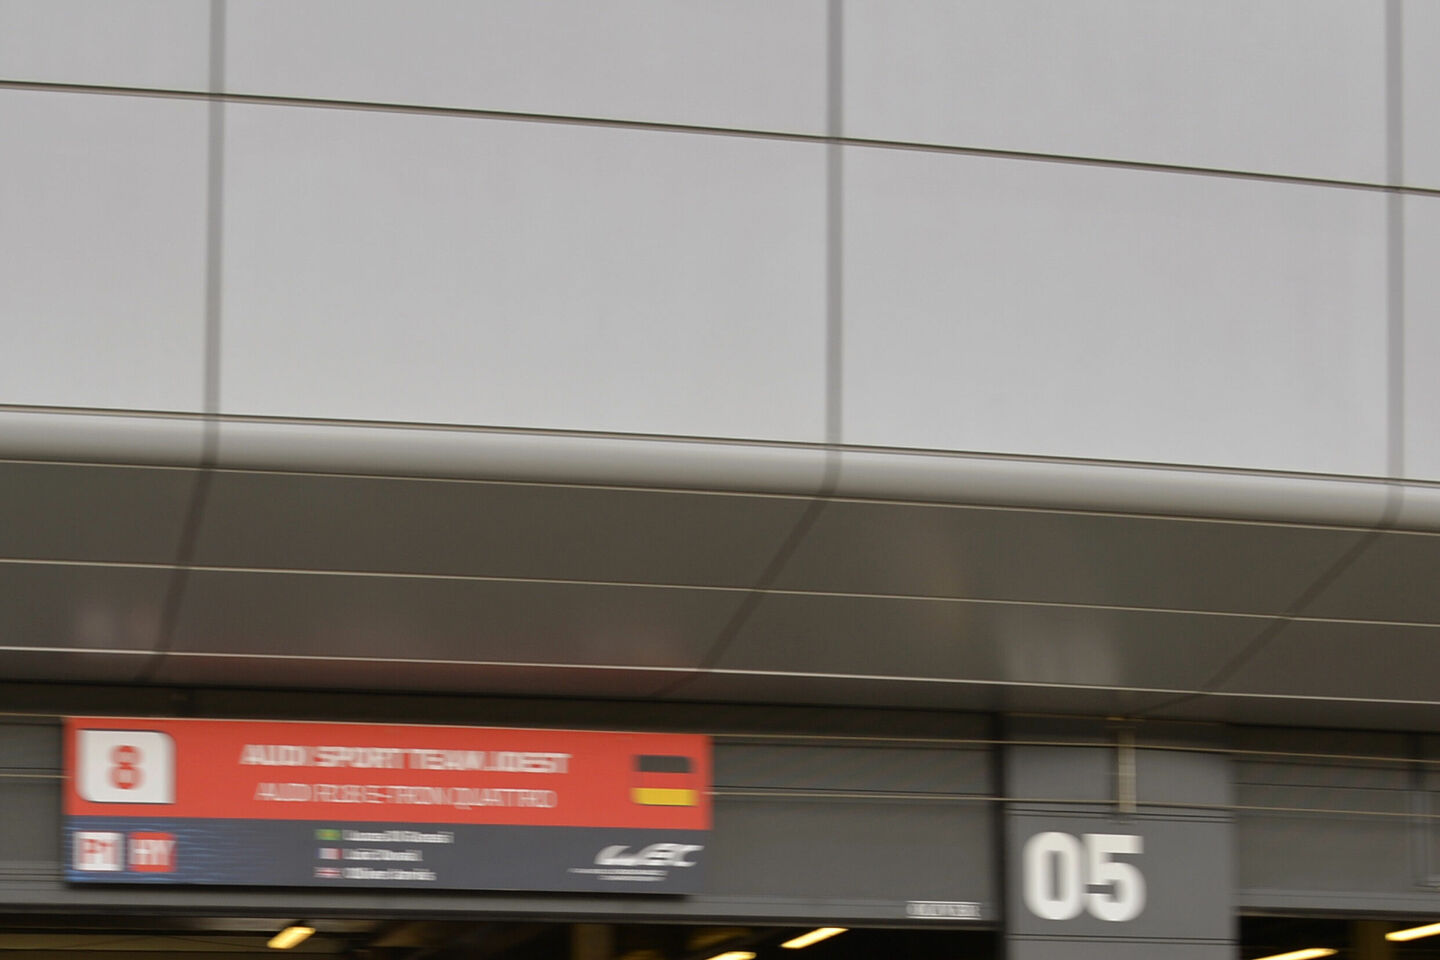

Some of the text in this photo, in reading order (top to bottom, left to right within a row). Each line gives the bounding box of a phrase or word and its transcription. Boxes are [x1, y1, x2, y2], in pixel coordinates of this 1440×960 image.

[108, 745, 144, 790] 8
[240, 744, 572, 773] AUDI SPORT TEAM JOEST
[1023, 832, 1147, 922] 05
